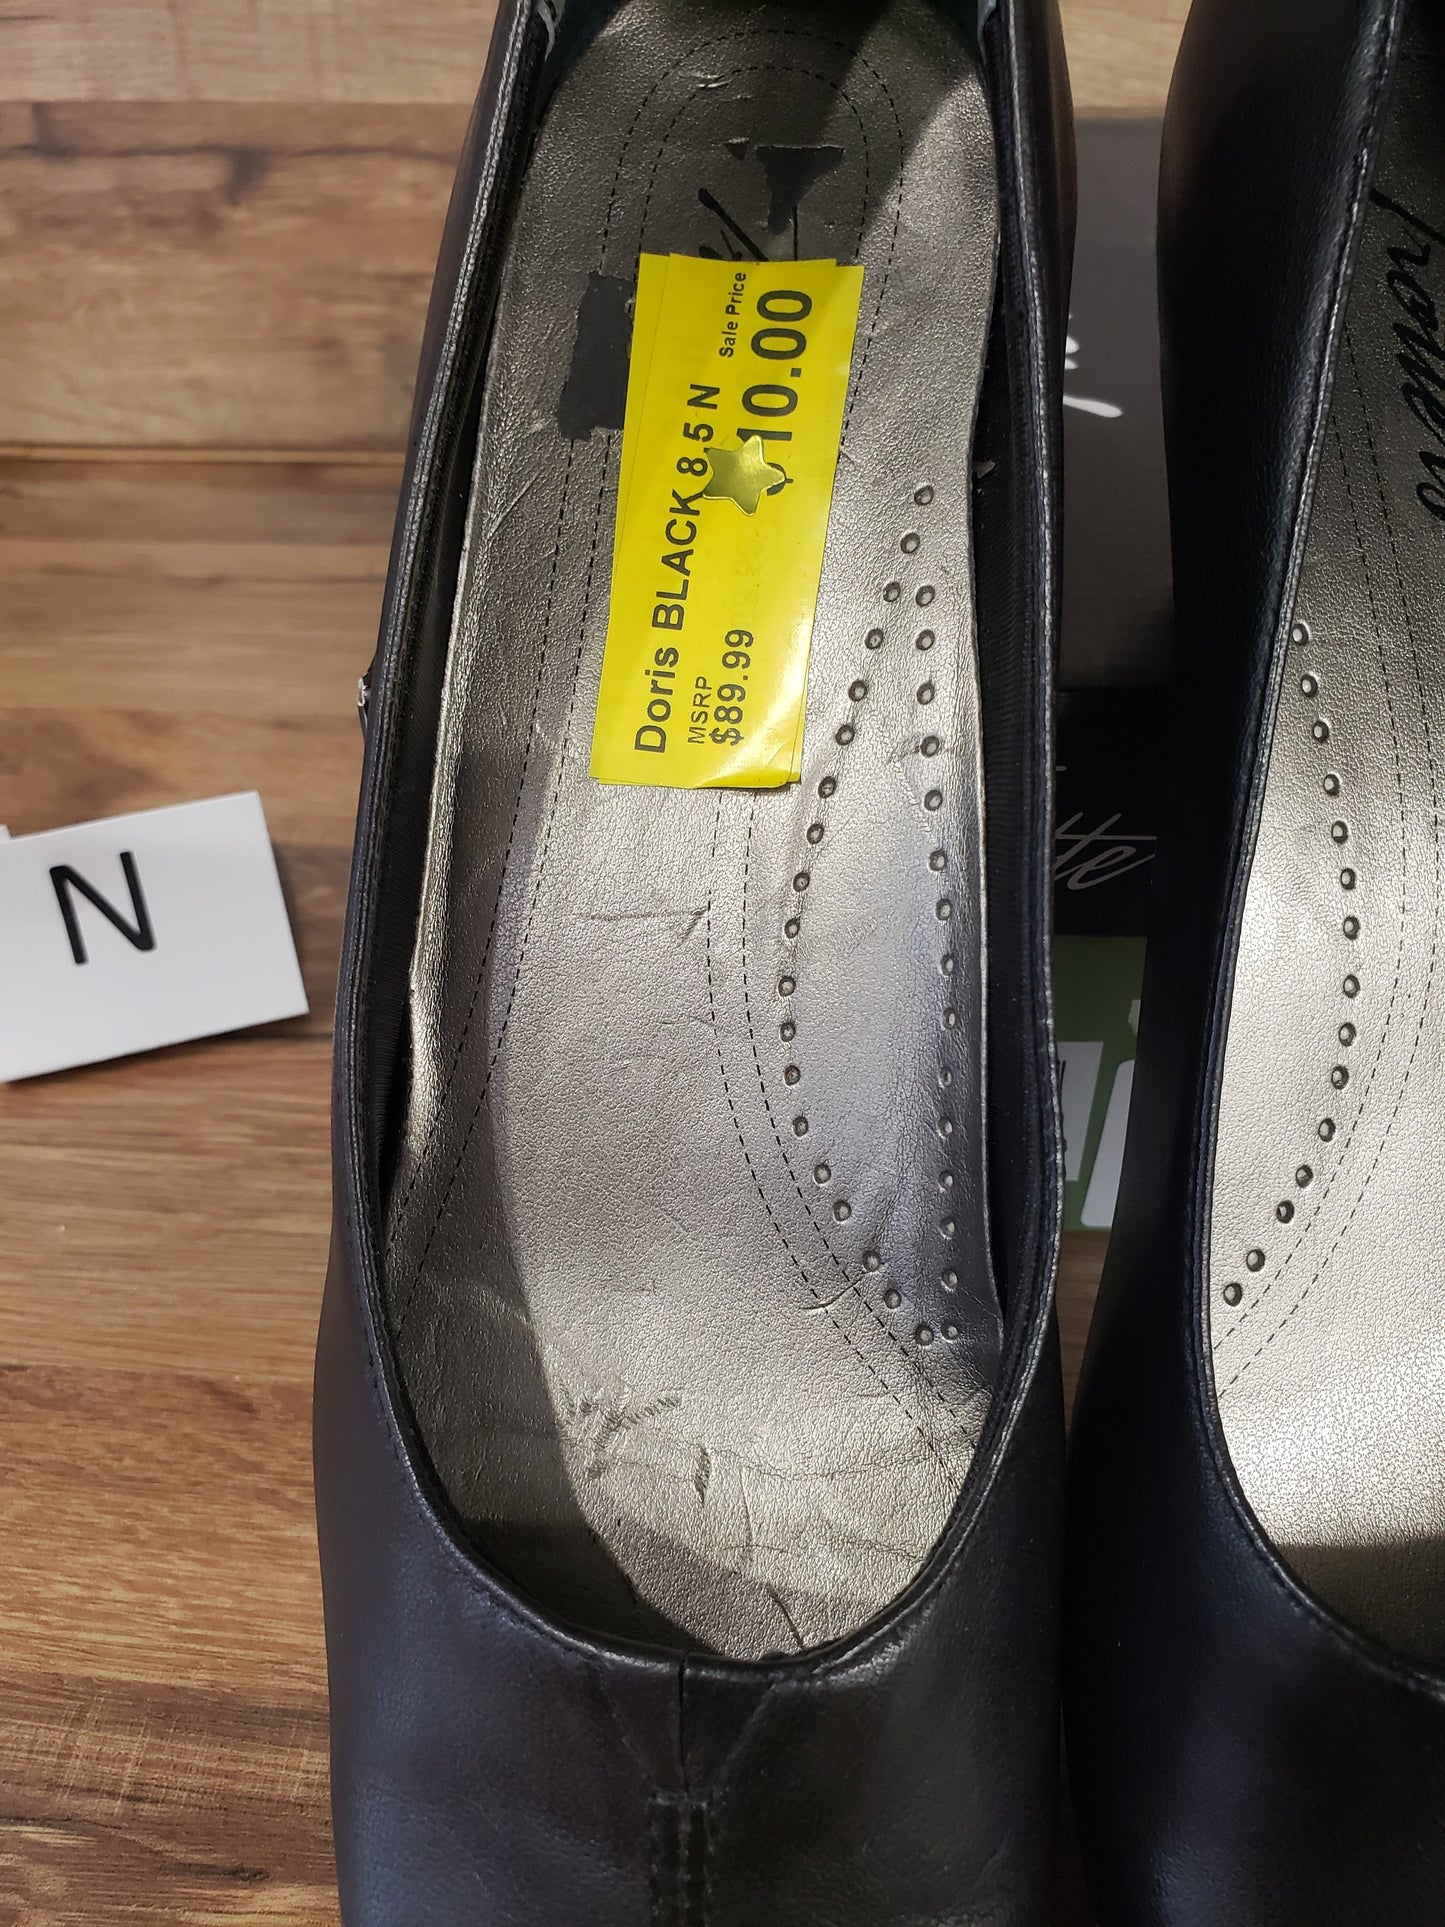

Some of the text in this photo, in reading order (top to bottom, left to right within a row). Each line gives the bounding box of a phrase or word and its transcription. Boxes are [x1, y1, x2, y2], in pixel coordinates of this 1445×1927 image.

[719, 272, 747, 358] Sale Price
[687, 384, 720, 410] N
[651, 489, 703, 631] BLACK
[634, 646, 680, 753] Doris
[687, 676, 713, 744] MSRP
[708, 629, 754, 747] $89.99
[49, 850, 157, 966] N
